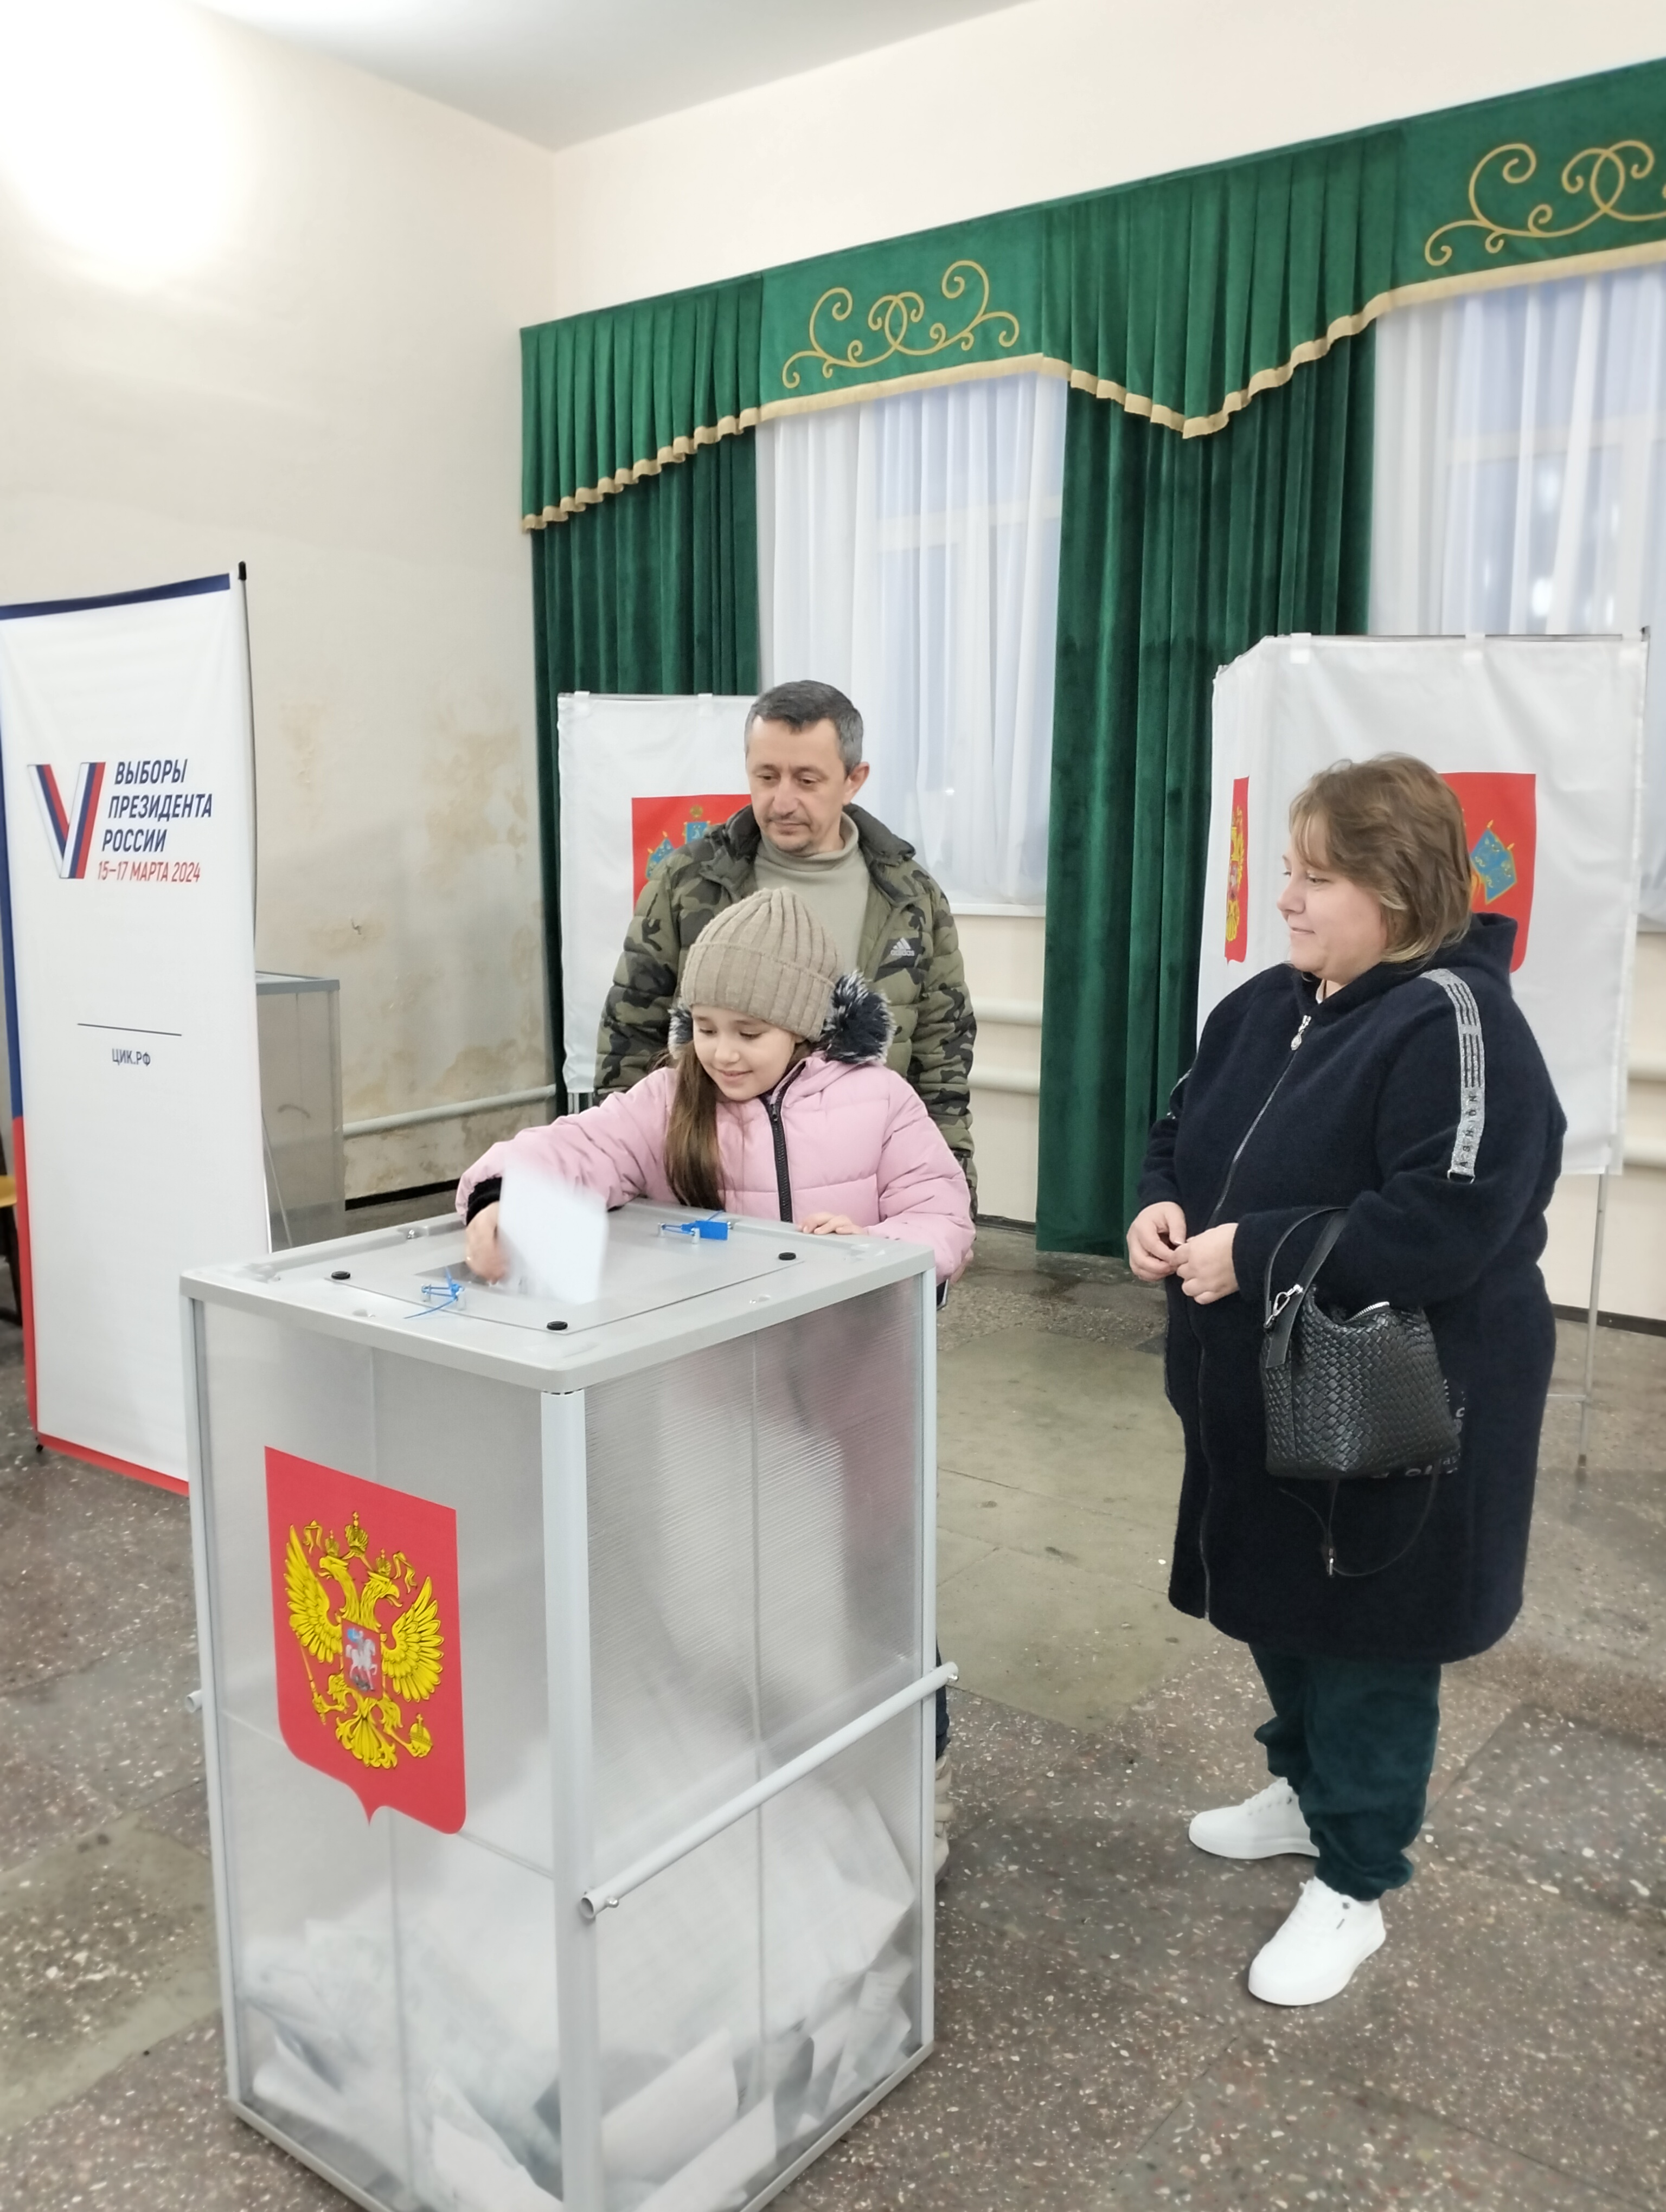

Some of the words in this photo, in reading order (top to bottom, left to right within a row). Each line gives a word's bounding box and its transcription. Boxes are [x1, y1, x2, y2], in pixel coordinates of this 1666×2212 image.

[114, 758, 188, 785] ВЫБОРЫ
[108, 793, 213, 822] ПРЕЗИДЕНТА
[101, 829, 167, 852] РОССИИ
[130, 861, 169, 881] МАРТА
[171, 862, 201, 882] 2024
[112, 1048, 151, 1066] ЦИК.РФ
